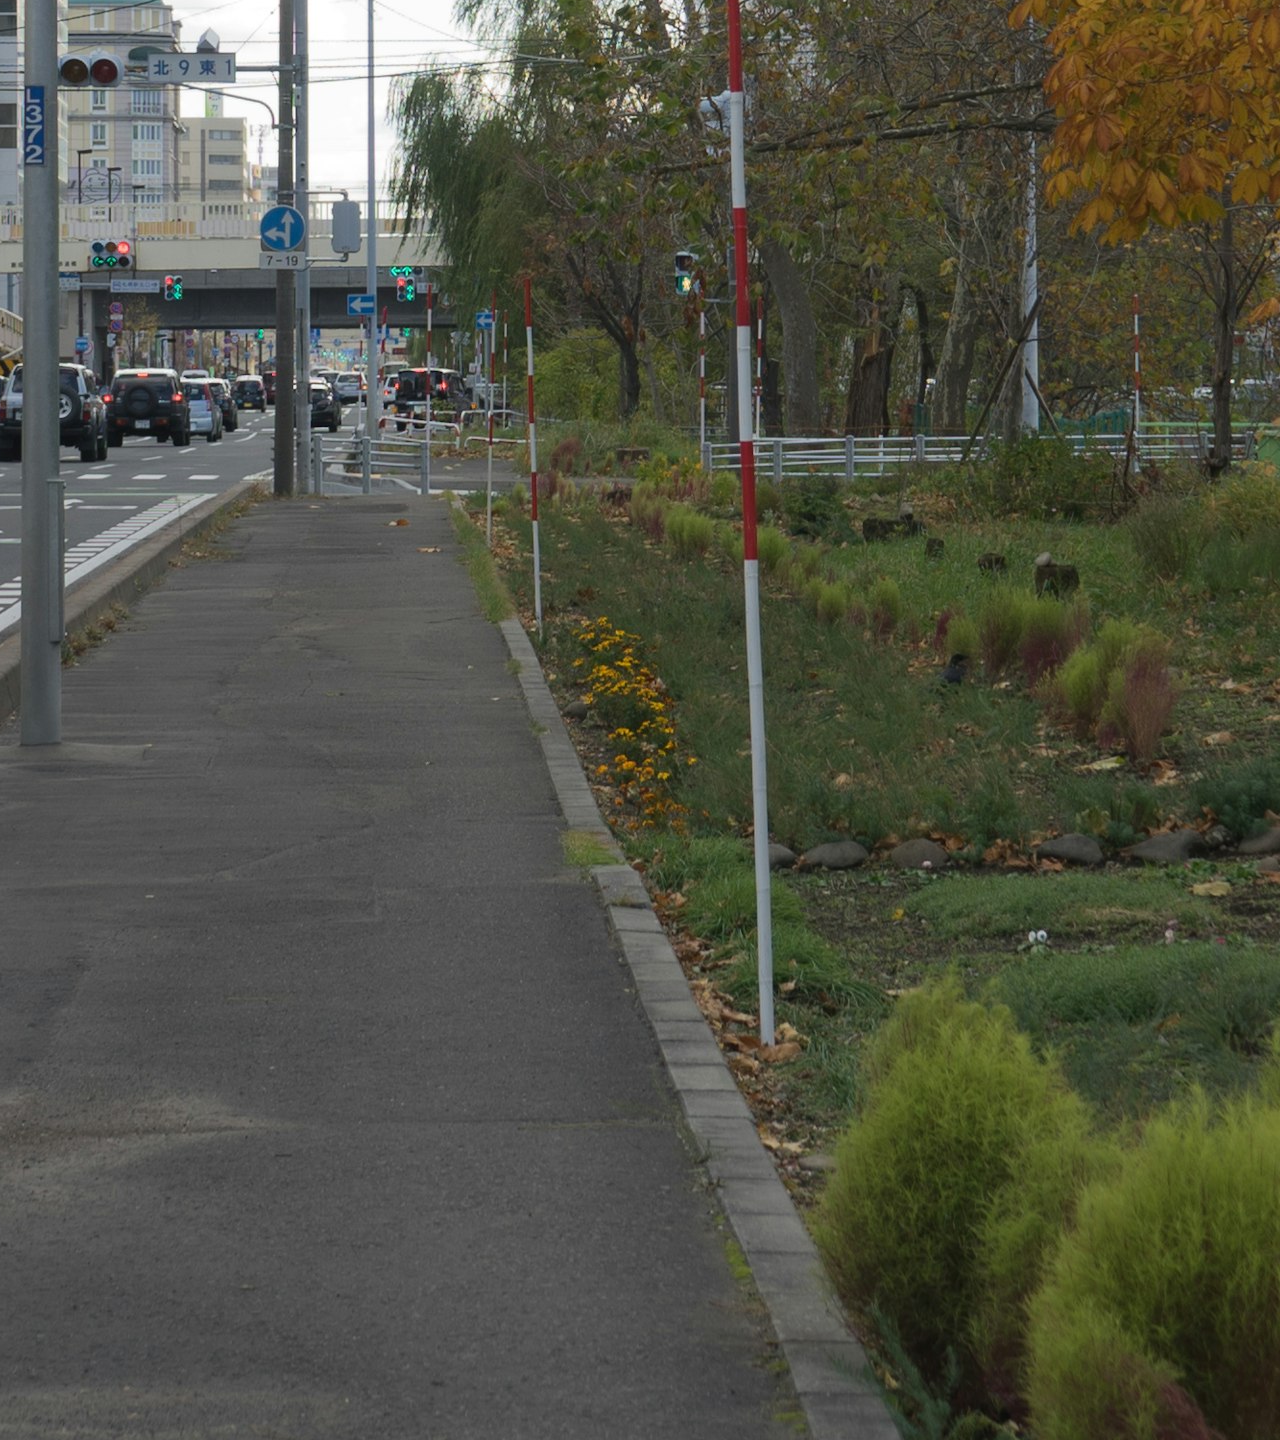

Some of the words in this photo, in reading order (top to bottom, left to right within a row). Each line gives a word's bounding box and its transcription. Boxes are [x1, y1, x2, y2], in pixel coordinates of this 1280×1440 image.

[153, 59, 231, 75] 北9東1
[26, 88, 42, 164] L372
[266, 255, 298, 266] 7-19
